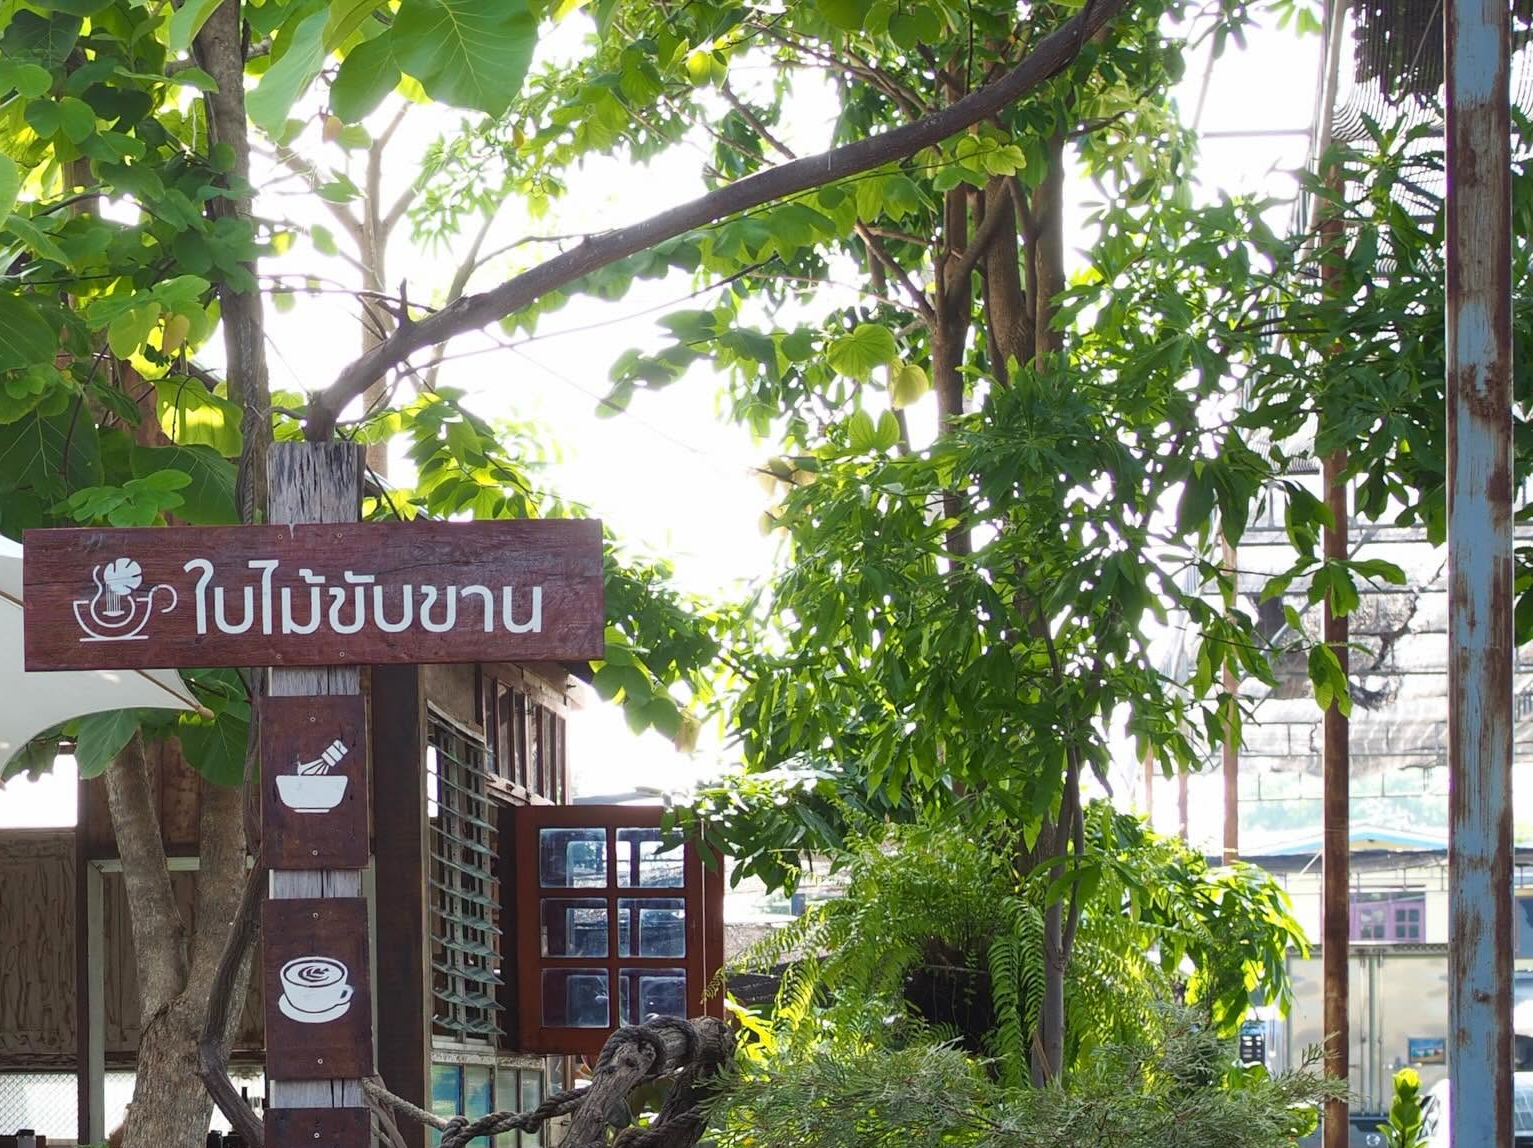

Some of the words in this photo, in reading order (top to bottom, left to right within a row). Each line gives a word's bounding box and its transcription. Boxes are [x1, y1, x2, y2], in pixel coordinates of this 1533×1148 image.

[183, 558, 542, 634] ใบไม้ขับขาน
